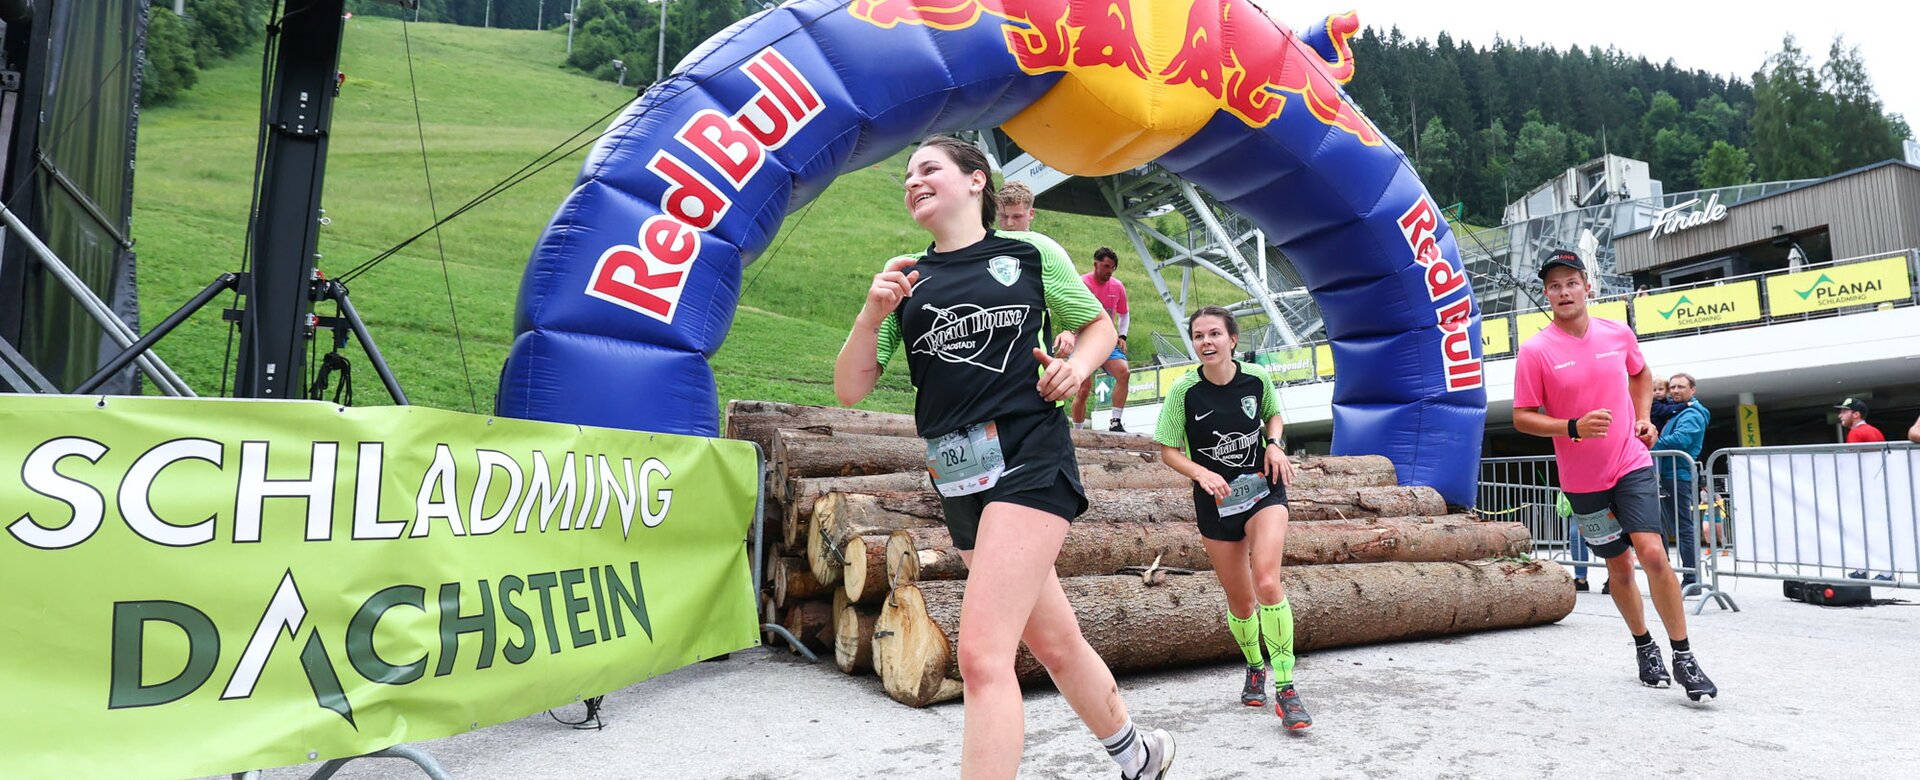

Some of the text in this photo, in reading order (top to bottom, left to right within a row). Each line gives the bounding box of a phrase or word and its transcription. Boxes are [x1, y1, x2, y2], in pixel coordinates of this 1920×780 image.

[585, 46, 827, 325] Red Bull
[1650, 193, 1729, 240] Finale
[1397, 194, 1483, 392] Red Bull
[1816, 279, 1883, 299] PLANAI
[1817, 293, 1867, 307] SCHLADMING
[1677, 300, 1736, 320] PLANAI
[1678, 314, 1722, 326] SCHLADMING
[925, 309, 1023, 352] Road House
[942, 340, 977, 352] RADSTADT
[1746, 423, 1756, 446] EX
[941, 445, 967, 467] 282
[6, 436, 673, 550] SCHLADMING
[1234, 484, 1250, 498] 279
[108, 561, 654, 731] DACHSTEIN
